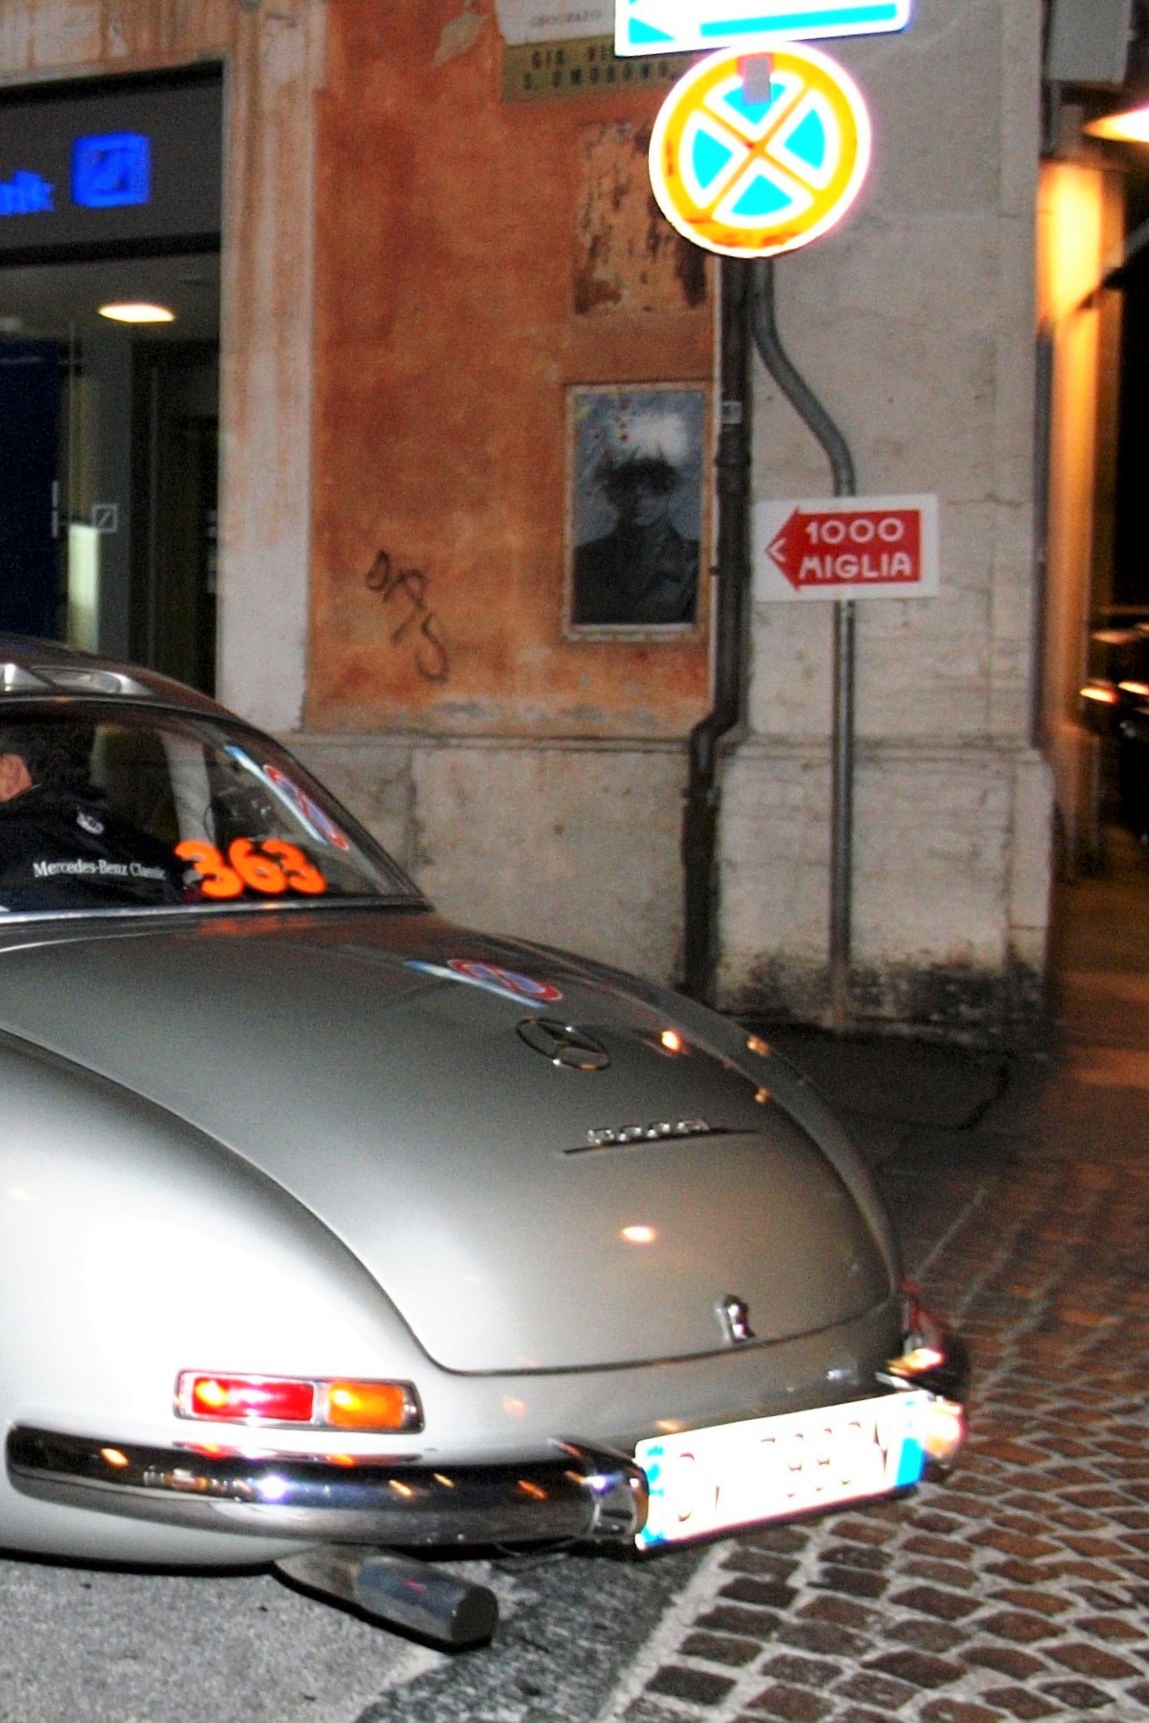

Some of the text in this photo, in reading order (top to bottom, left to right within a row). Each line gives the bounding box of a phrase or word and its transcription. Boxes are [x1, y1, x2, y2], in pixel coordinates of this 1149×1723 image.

[805, 517, 904, 545] 1000
[798, 551, 913, 579] MIGLIA
[175, 837, 327, 898] 363
